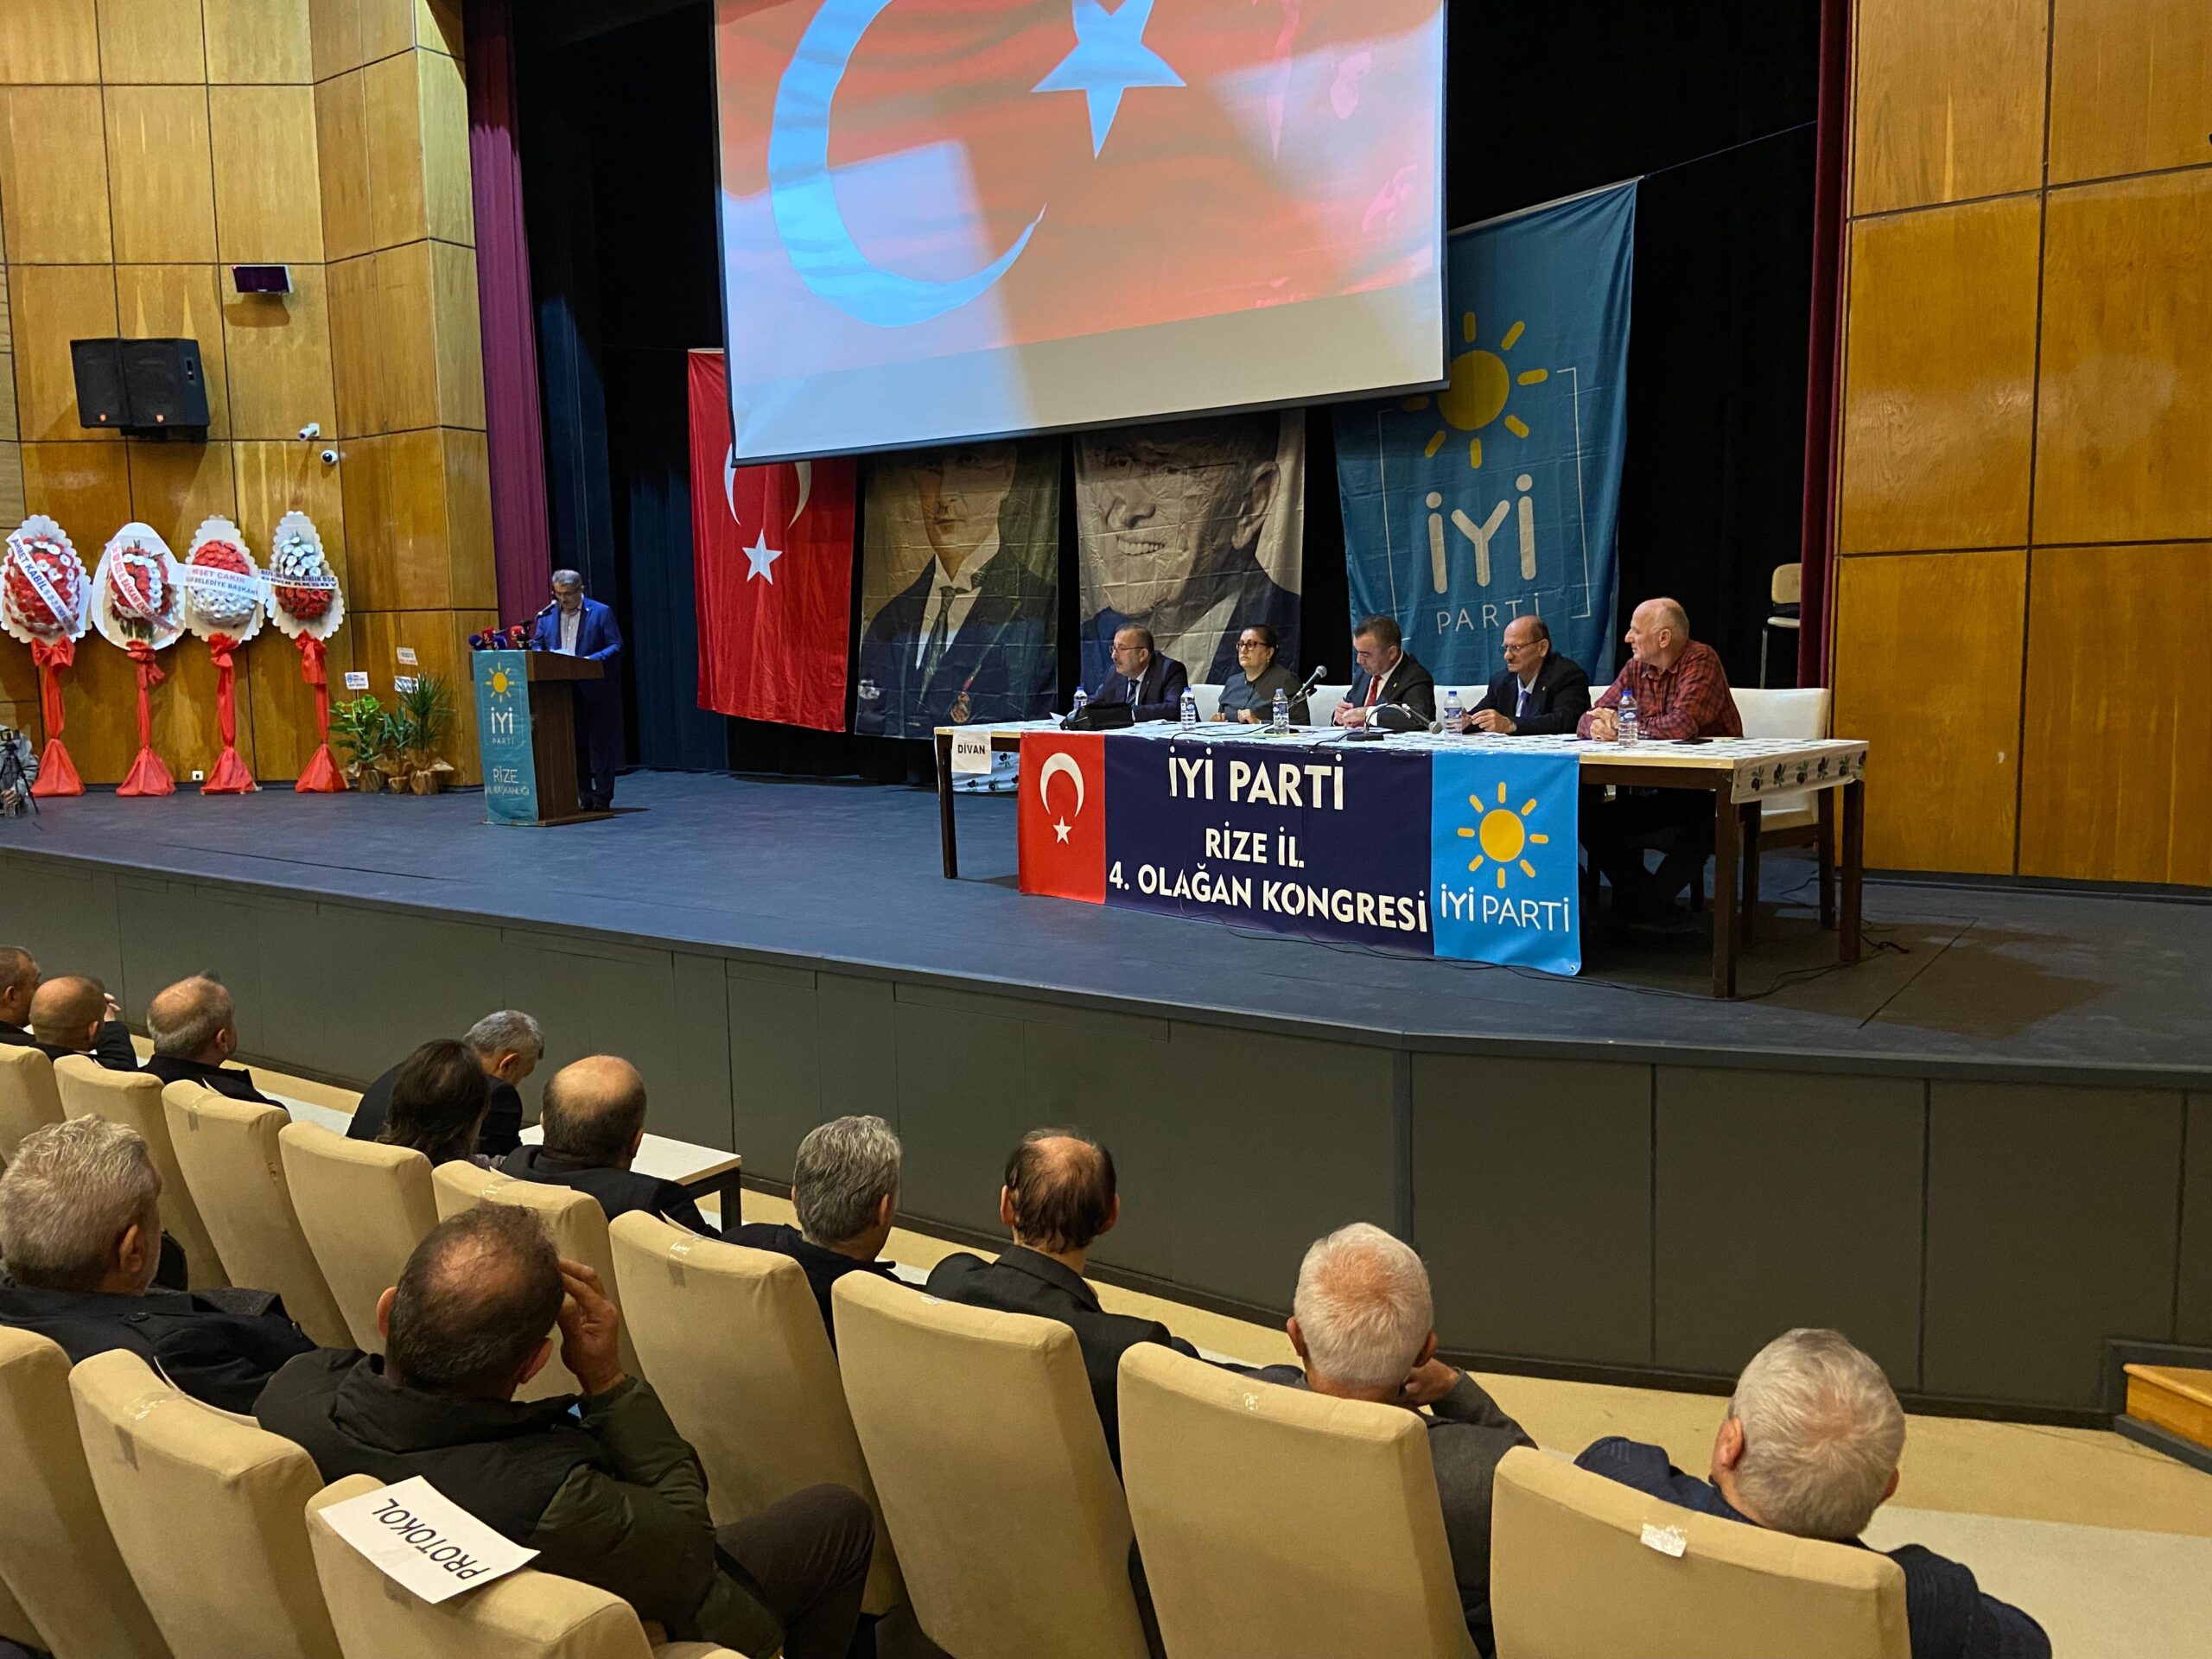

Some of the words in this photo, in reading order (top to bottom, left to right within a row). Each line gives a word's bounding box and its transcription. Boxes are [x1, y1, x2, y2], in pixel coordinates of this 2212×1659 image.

[1426, 474, 1536, 594] İYİ
[12, 537, 29, 563] AHMET
[24, 563, 48, 591] KABİL
[194, 577, 226, 588] BELEDİYE
[1436, 593, 1541, 635] PARTİ
[491, 707, 513, 734] İYİ
[492, 737, 514, 746] PARTİ
[957, 742, 986, 754] DİVAN
[493, 766, 519, 785] RİZE
[1168, 745, 1214, 800] İYİ
[1230, 753, 1344, 810] PARTİ
[1205, 821, 1268, 863] RİZE
[1278, 826, 1305, 868] İL
[1109, 861, 1130, 890] 4.
[1137, 862, 1251, 909] OLAĞAN
[1262, 880, 1427, 933] KONGRESİ
[1440, 883, 1475, 922] İYİ
[1482, 894, 1570, 933] PARTİ
[372, 1497, 491, 1580] PROTOKOL
